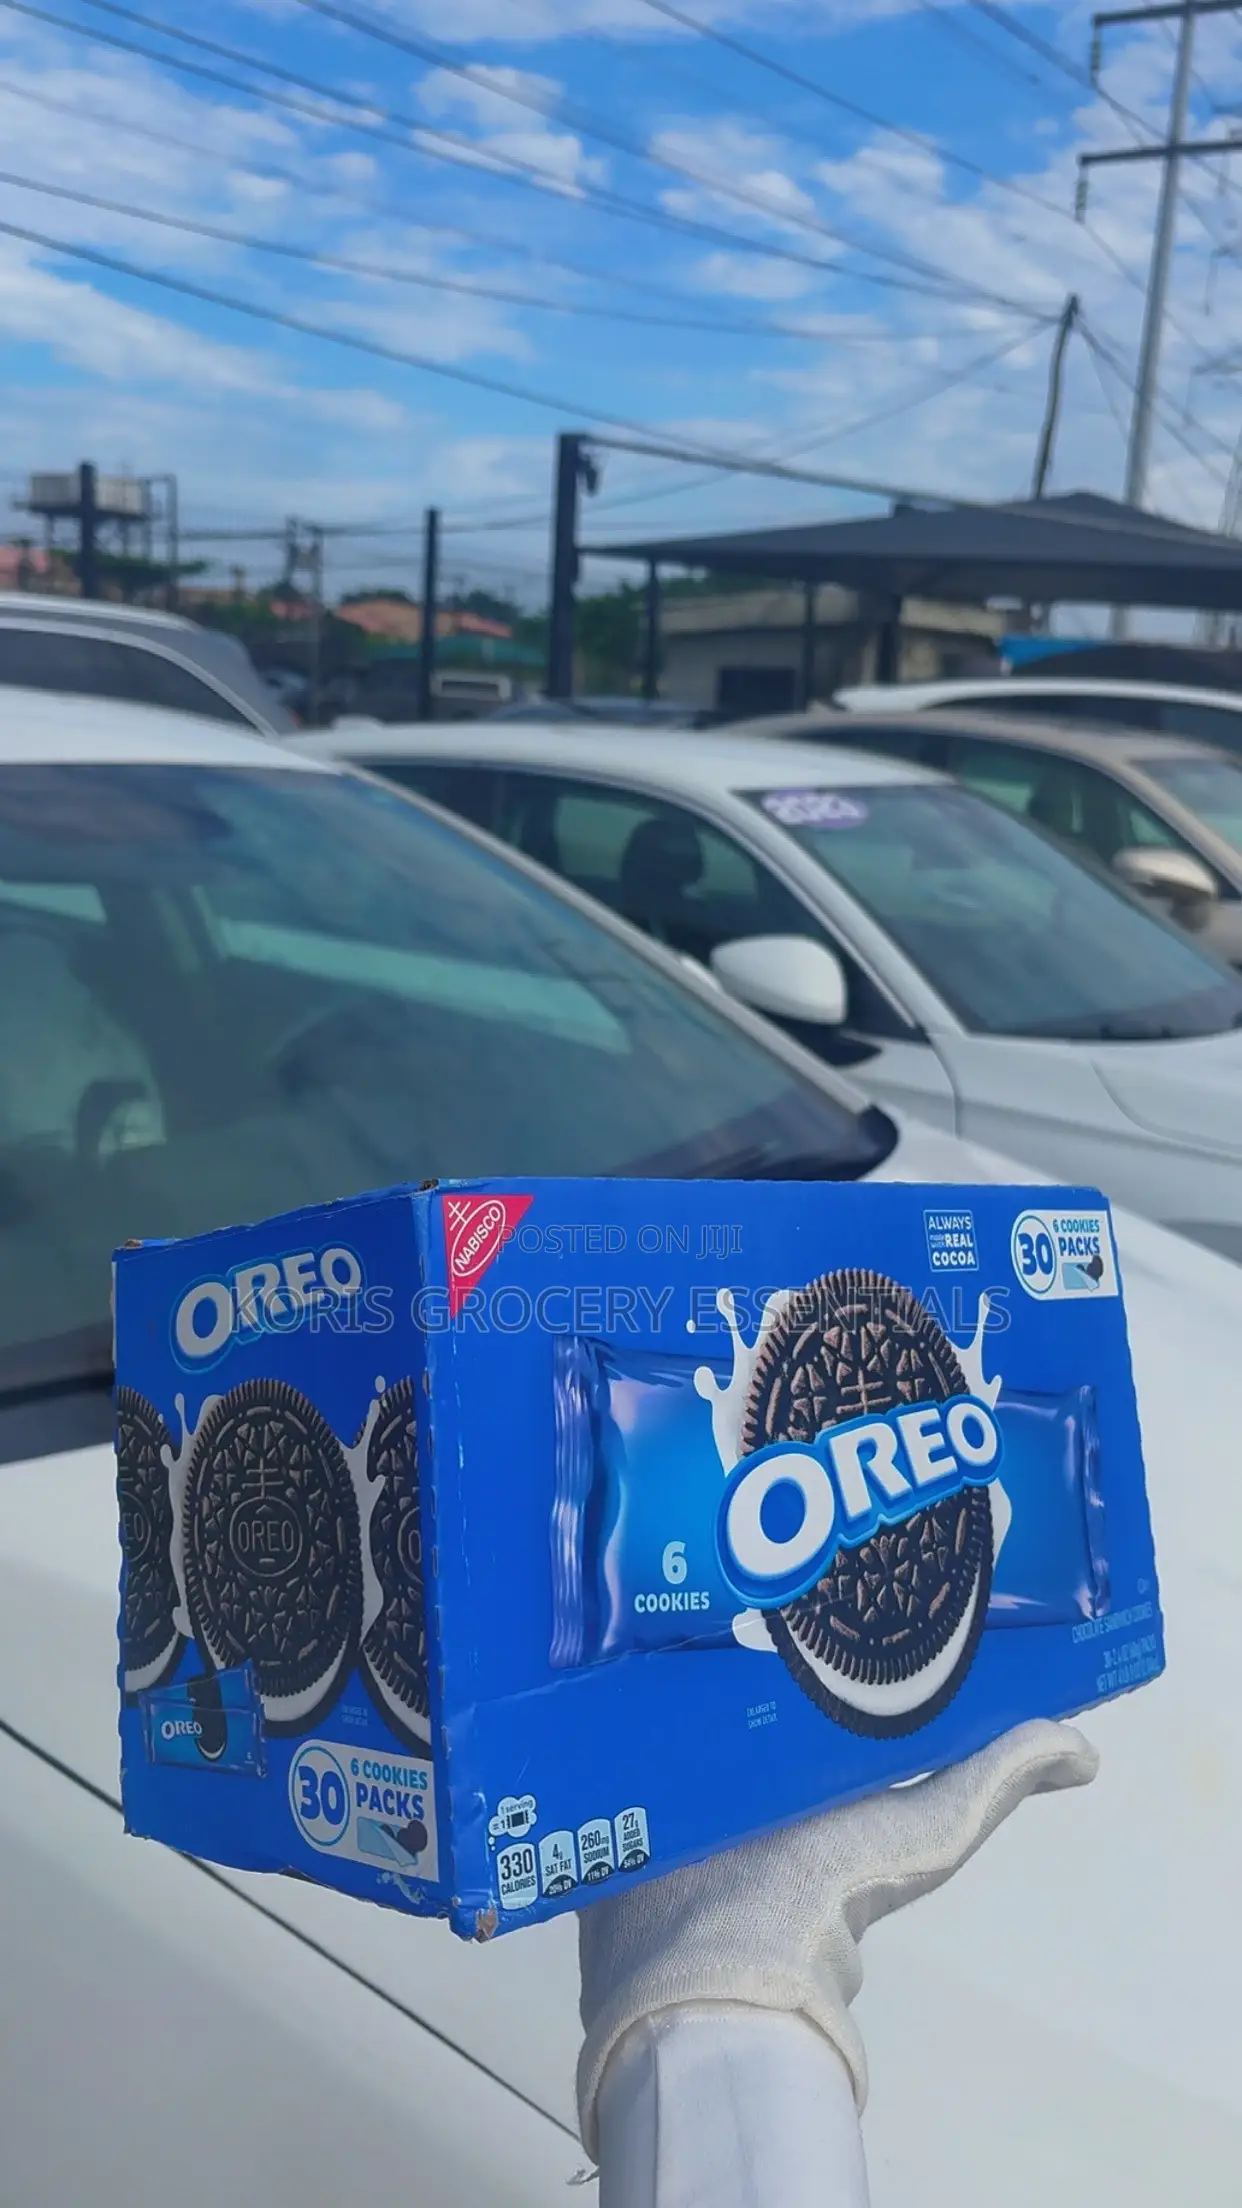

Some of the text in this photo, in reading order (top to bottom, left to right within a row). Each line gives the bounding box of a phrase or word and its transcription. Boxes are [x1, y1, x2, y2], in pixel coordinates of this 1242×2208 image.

[929, 1216, 972, 1230] ALWAYS
[1053, 1219, 1100, 1233] 6 COOKIES
[454, 1206, 501, 1271] NABISCO
[945, 1234, 973, 1248] REAL
[1058, 1237, 1100, 1256] PACKS
[932, 1251, 975, 1266] COCOA
[1018, 1233, 1053, 1275] 30
[176, 1248, 361, 1358] OREO
[727, 1403, 996, 1578] OREO
[238, 1520, 294, 1552] OREO
[662, 1542, 687, 1584] 6
[634, 1591, 710, 1614] COOKIES
[161, 1720, 202, 1740] OREO
[351, 1758, 428, 1790] 6 COOKIES
[298, 1766, 345, 1825] 30
[356, 1782, 424, 1820] PACKS
[506, 1800, 533, 1812] serving
[500, 1848, 533, 1880] 330
[584, 1846, 609, 1863] SODIUM
[545, 1859, 572, 1876] SAT FAT
[501, 1875, 536, 1895] CALORIES
